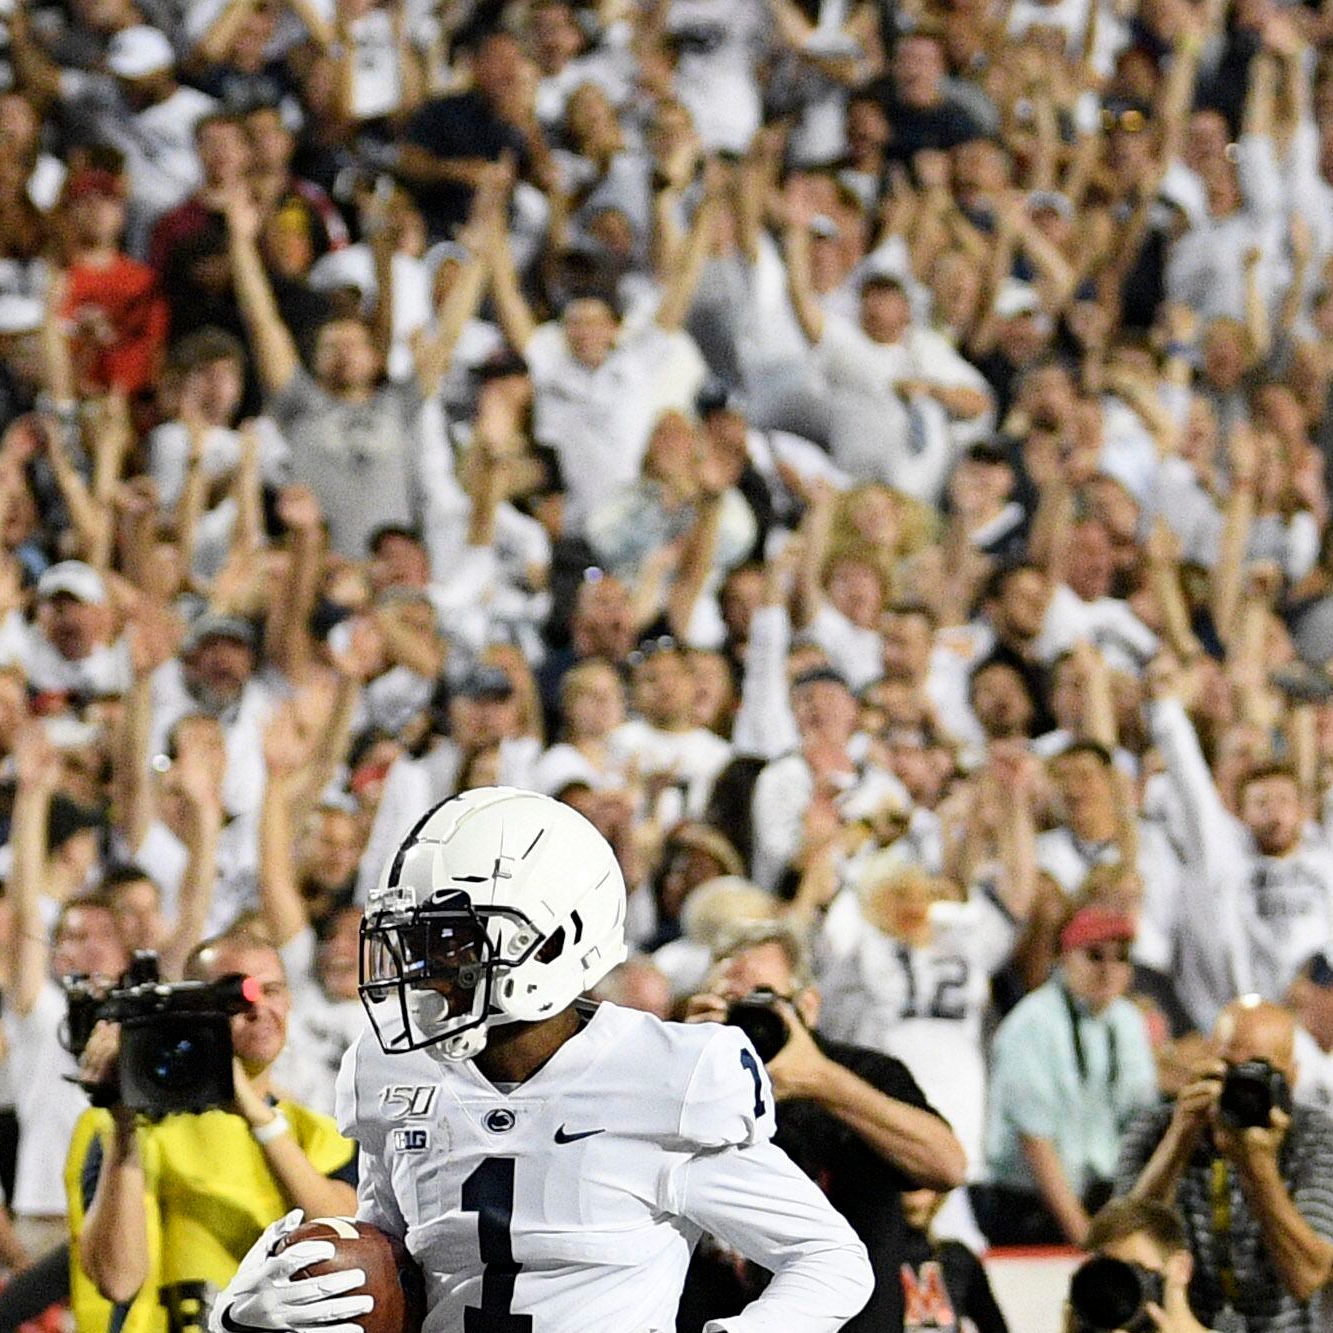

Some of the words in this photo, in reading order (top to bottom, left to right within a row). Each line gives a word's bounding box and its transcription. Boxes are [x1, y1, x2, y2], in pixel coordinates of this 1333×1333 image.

[892, 945, 970, 1020] 12
[740, 1047, 766, 1120] 1
[899, 1261, 956, 1328] M
